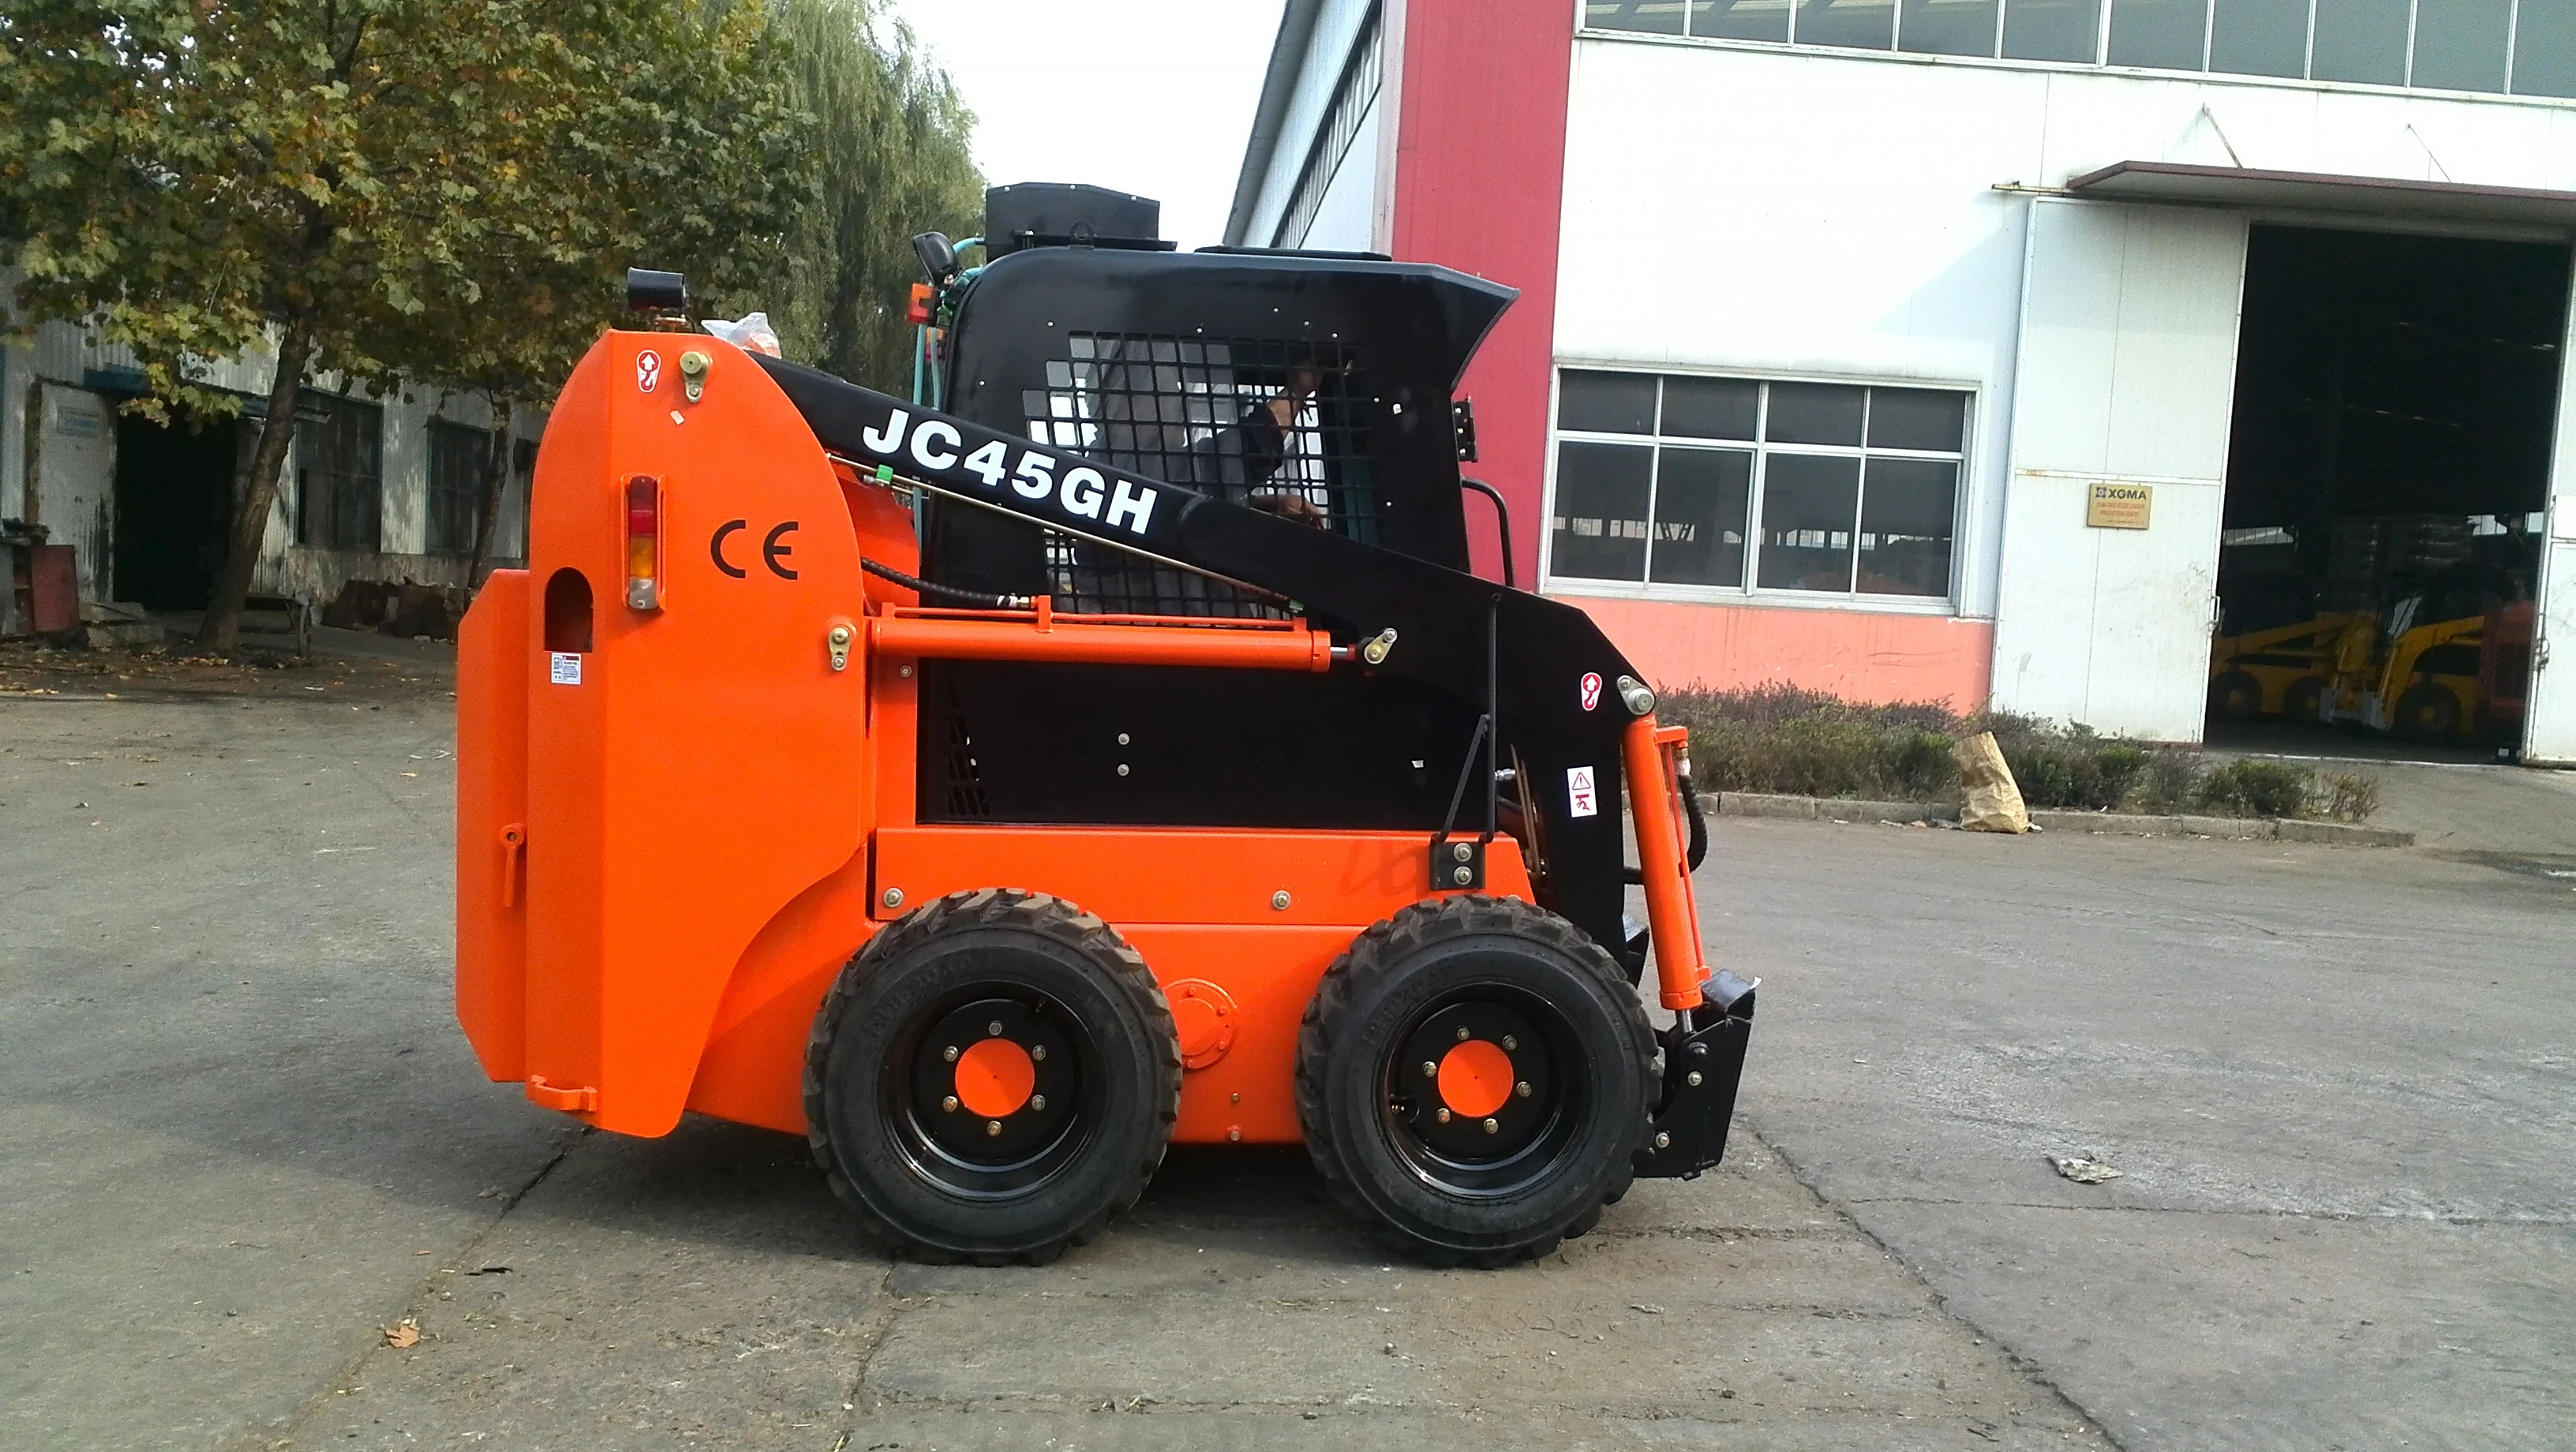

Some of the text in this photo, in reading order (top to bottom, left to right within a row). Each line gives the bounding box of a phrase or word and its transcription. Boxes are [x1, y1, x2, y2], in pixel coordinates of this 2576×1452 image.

[863, 408, 1158, 535] JC45GH
[2108, 488, 2147, 500] XGMA
[710, 519, 799, 580] CE
